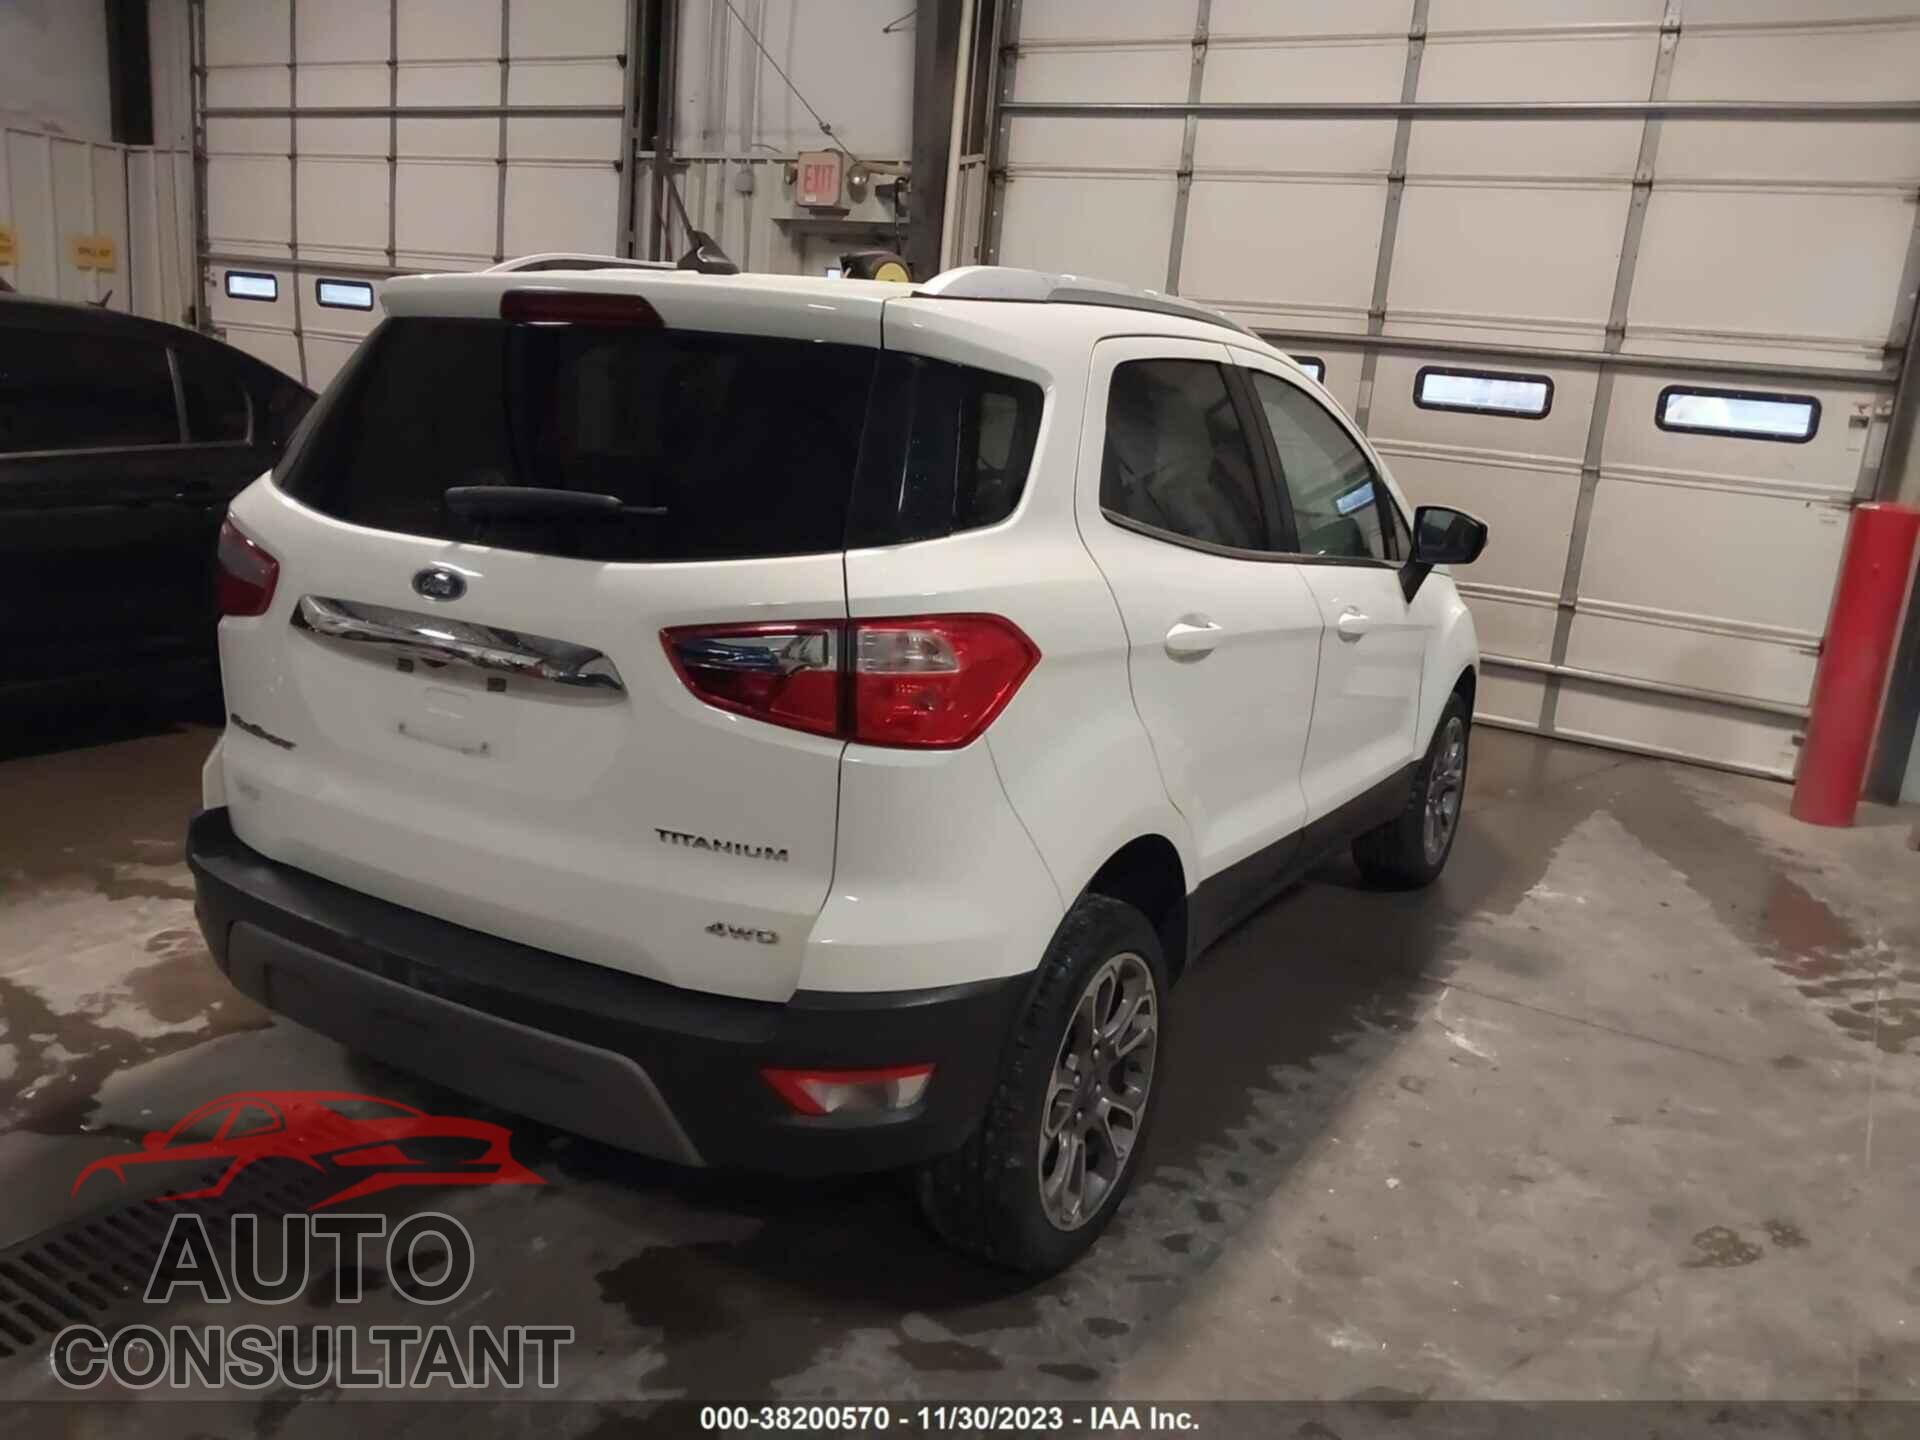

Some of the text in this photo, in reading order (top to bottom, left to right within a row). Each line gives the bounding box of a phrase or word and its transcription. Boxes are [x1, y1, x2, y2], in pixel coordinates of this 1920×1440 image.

[804, 164, 834, 193] EXIT
[655, 828, 788, 862] TITANIUM
[705, 922, 779, 944] 4WD
